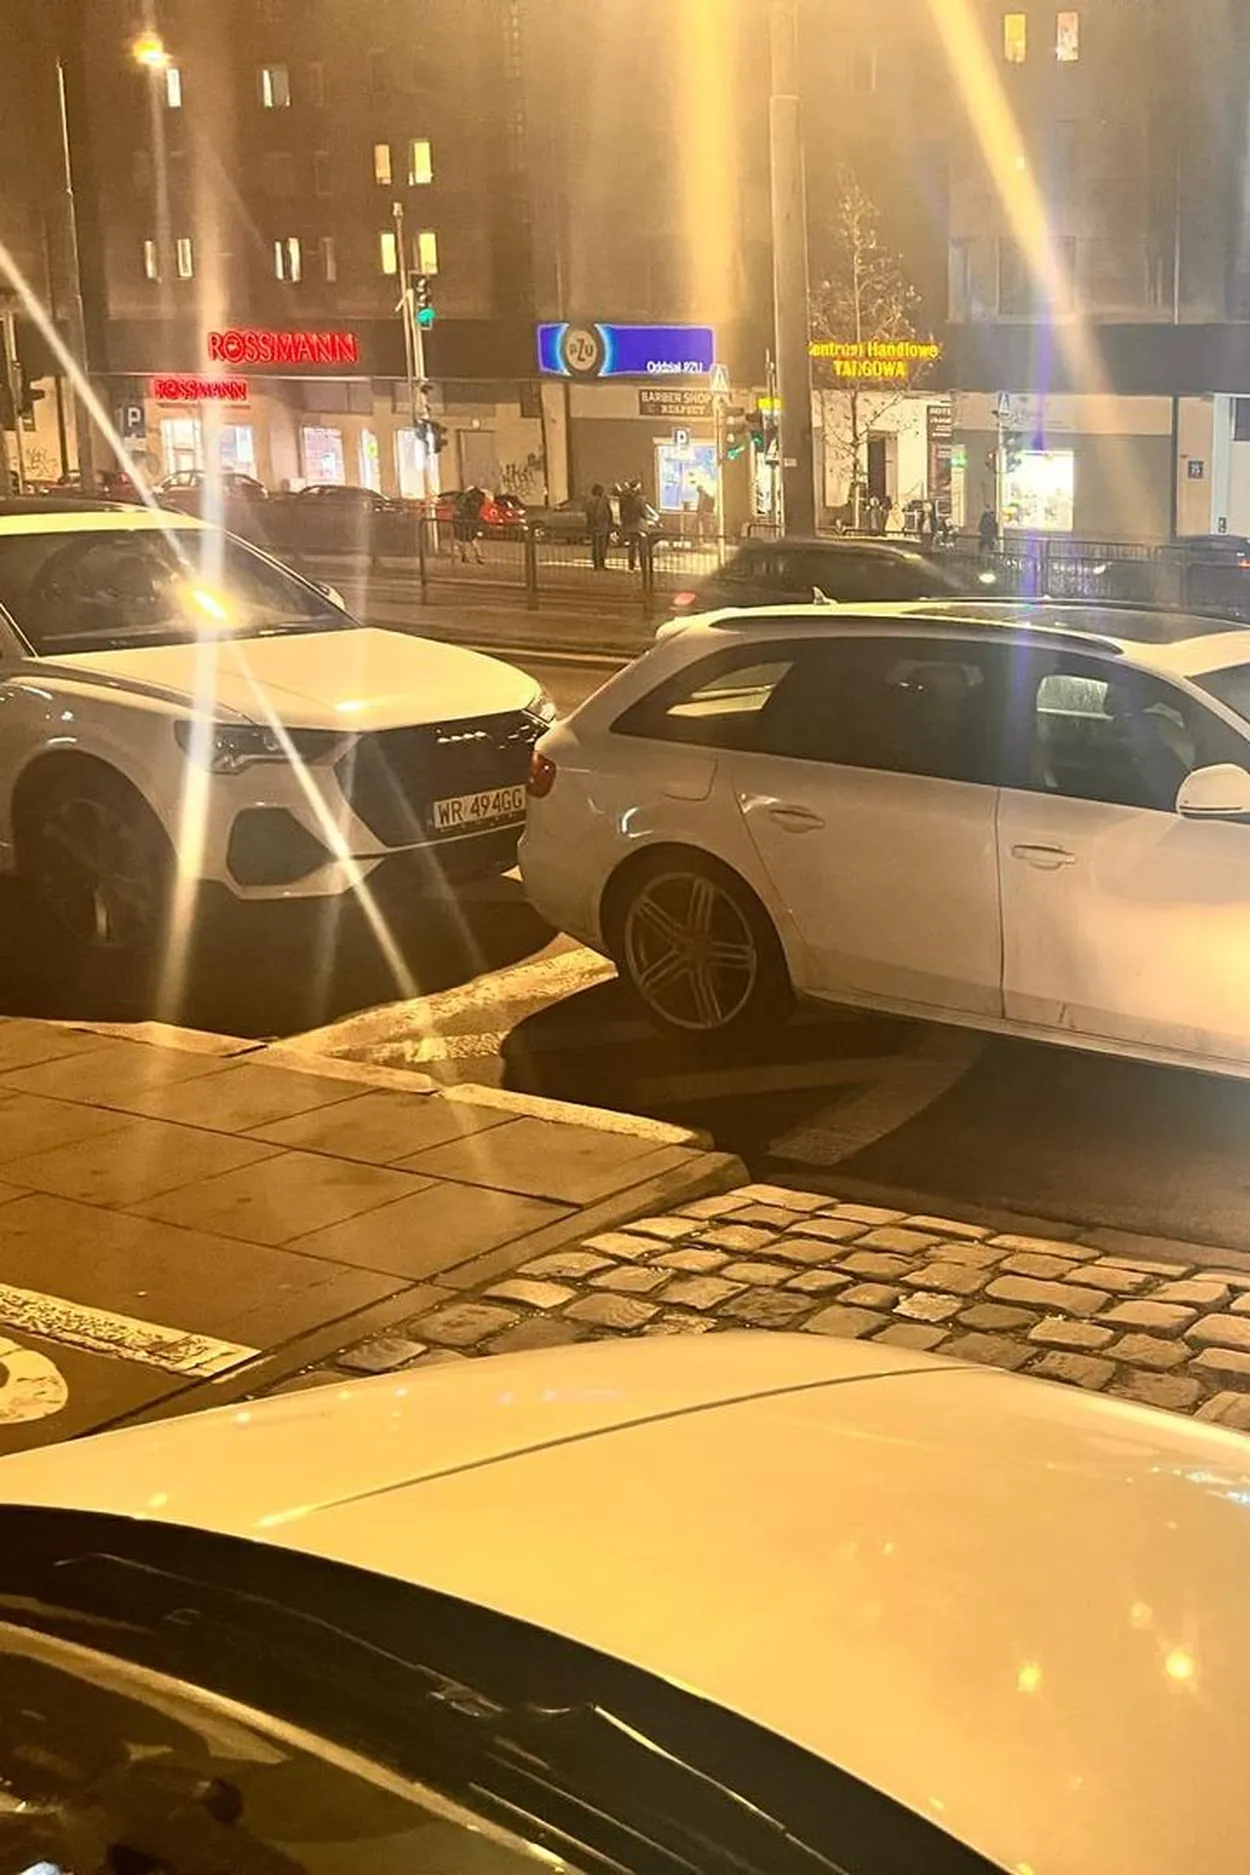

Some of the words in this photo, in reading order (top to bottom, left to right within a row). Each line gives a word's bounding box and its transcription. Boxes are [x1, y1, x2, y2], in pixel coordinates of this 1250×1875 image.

[208, 332, 358, 364] ROSSMANN
[569, 337, 594, 362] PZU
[153, 379, 248, 400] ROSSMANN
[437, 800, 464, 825] WR
